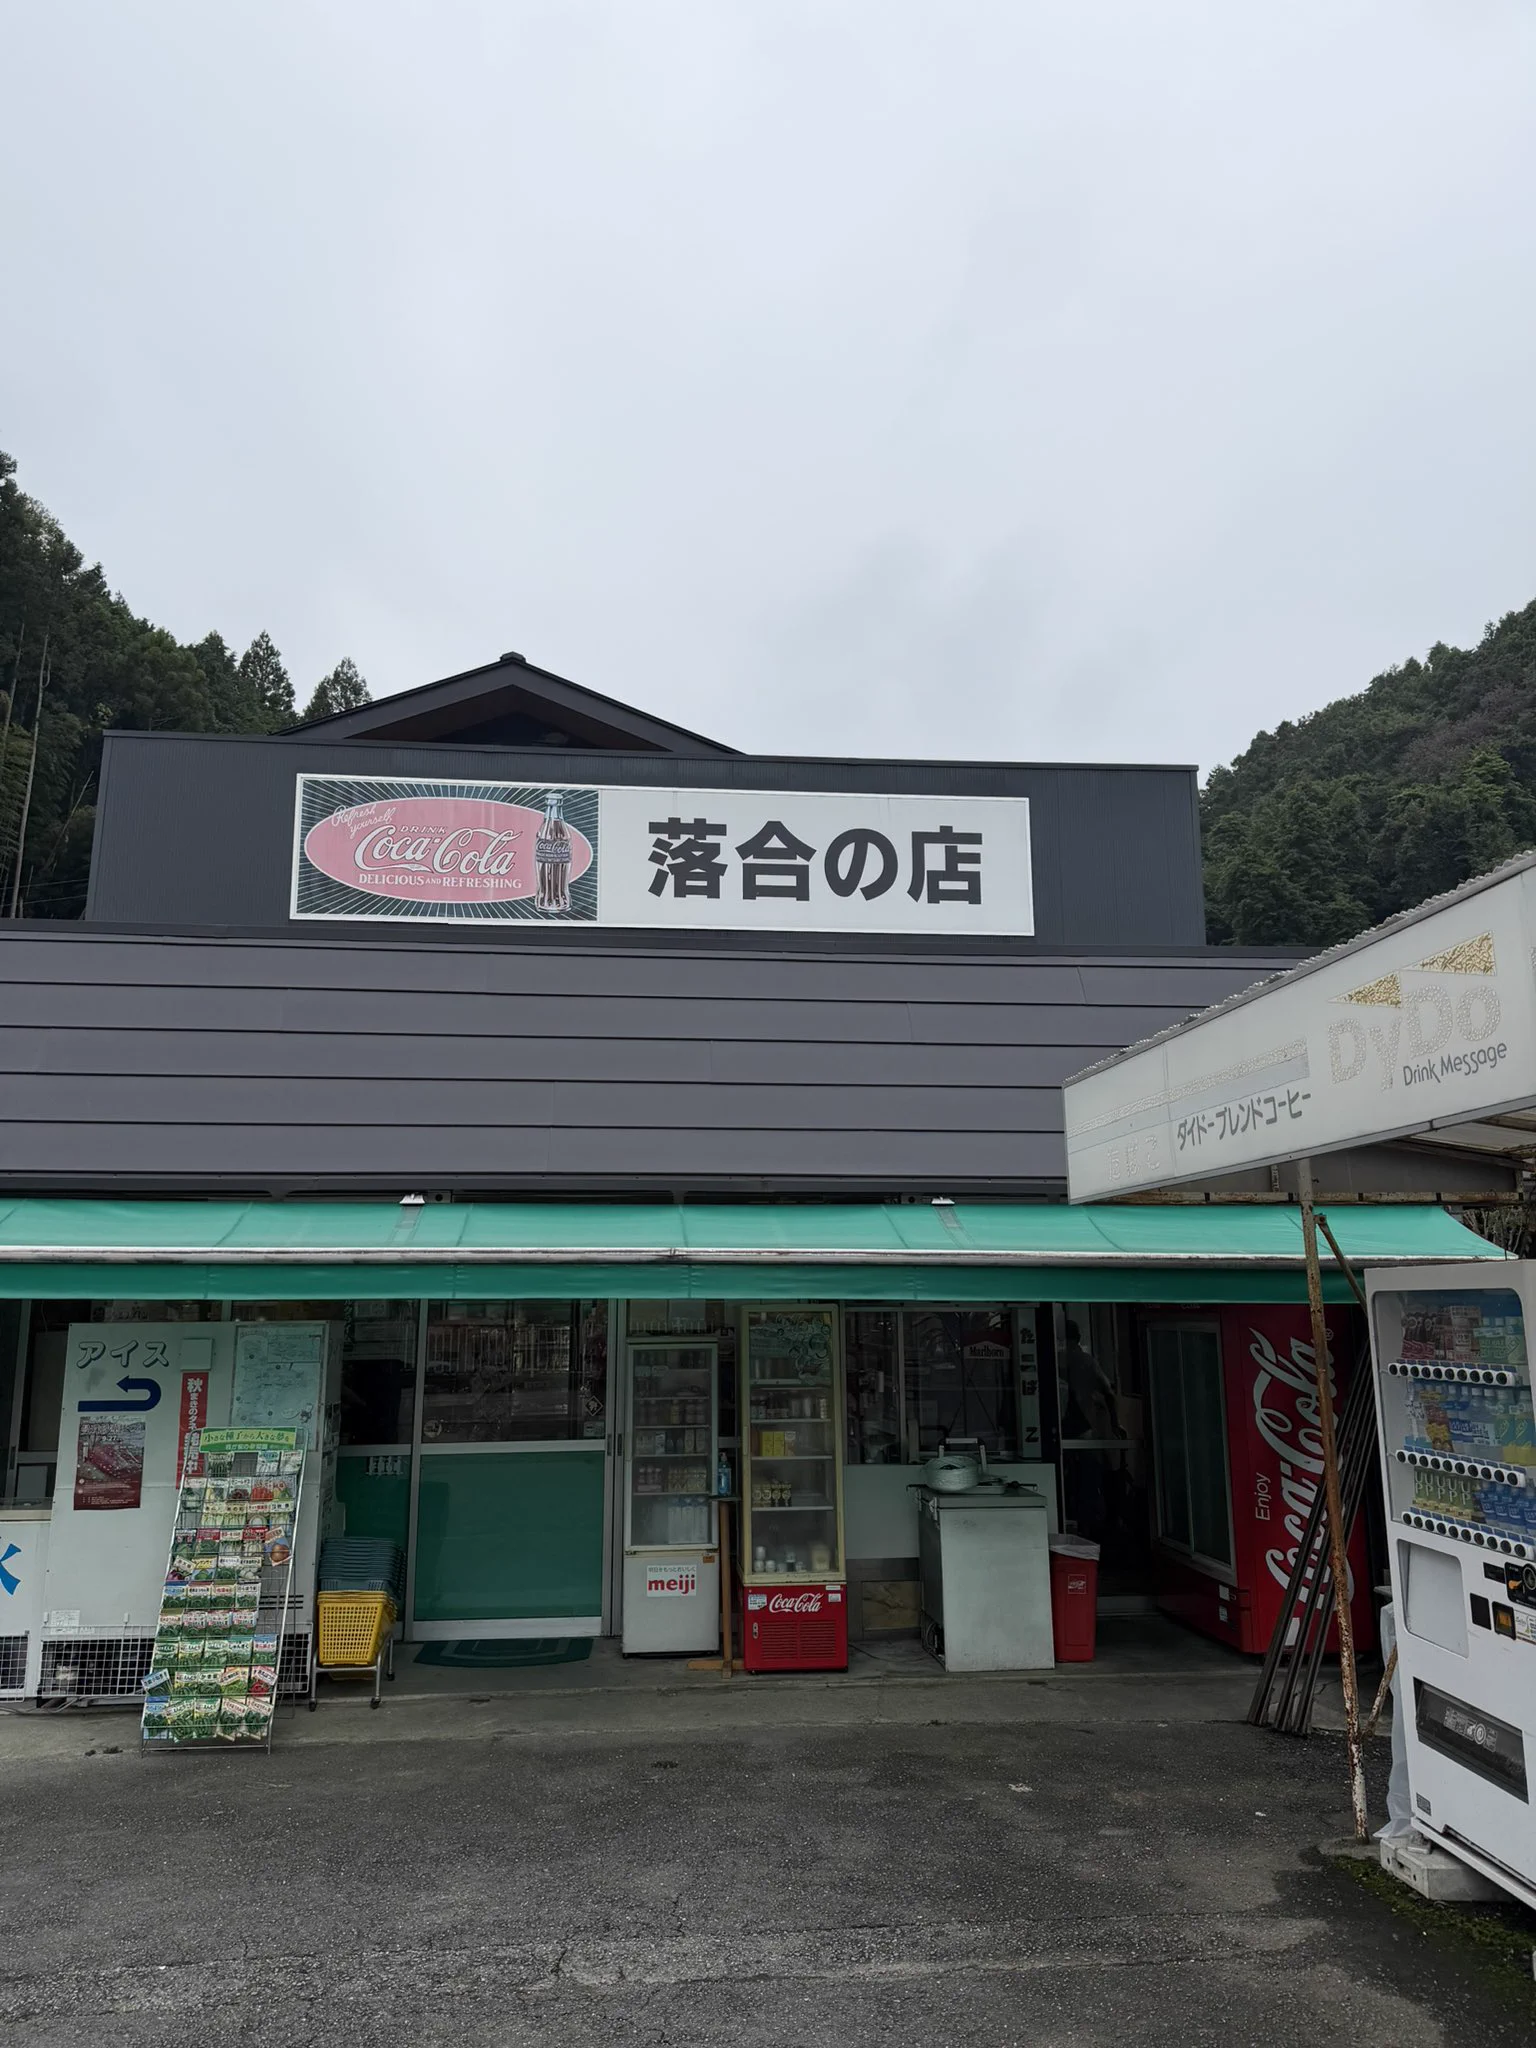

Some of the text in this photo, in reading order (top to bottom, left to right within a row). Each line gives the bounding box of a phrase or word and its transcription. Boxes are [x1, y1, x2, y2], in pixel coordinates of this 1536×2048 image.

[331, 804, 376, 827] Refresh
[350, 807, 397, 839] yourself
[400, 825, 446, 835] DRINK
[354, 825, 522, 875] Coca-Cola
[647, 817, 983, 905] 落合の店
[359, 874, 522, 889] DELICIOUS AND REFRESHING
[1403, 1042, 1507, 1086] Drink Message
[1177, 1089, 1311, 1151] ダイドーブレンドコーヒー
[77, 1340, 169, 1369] アイス
[1255, 1472, 1271, 1521] Enjoy
[648, 1574, 695, 1594] meiji
[769, 1592, 824, 1613] Coca-Cola
